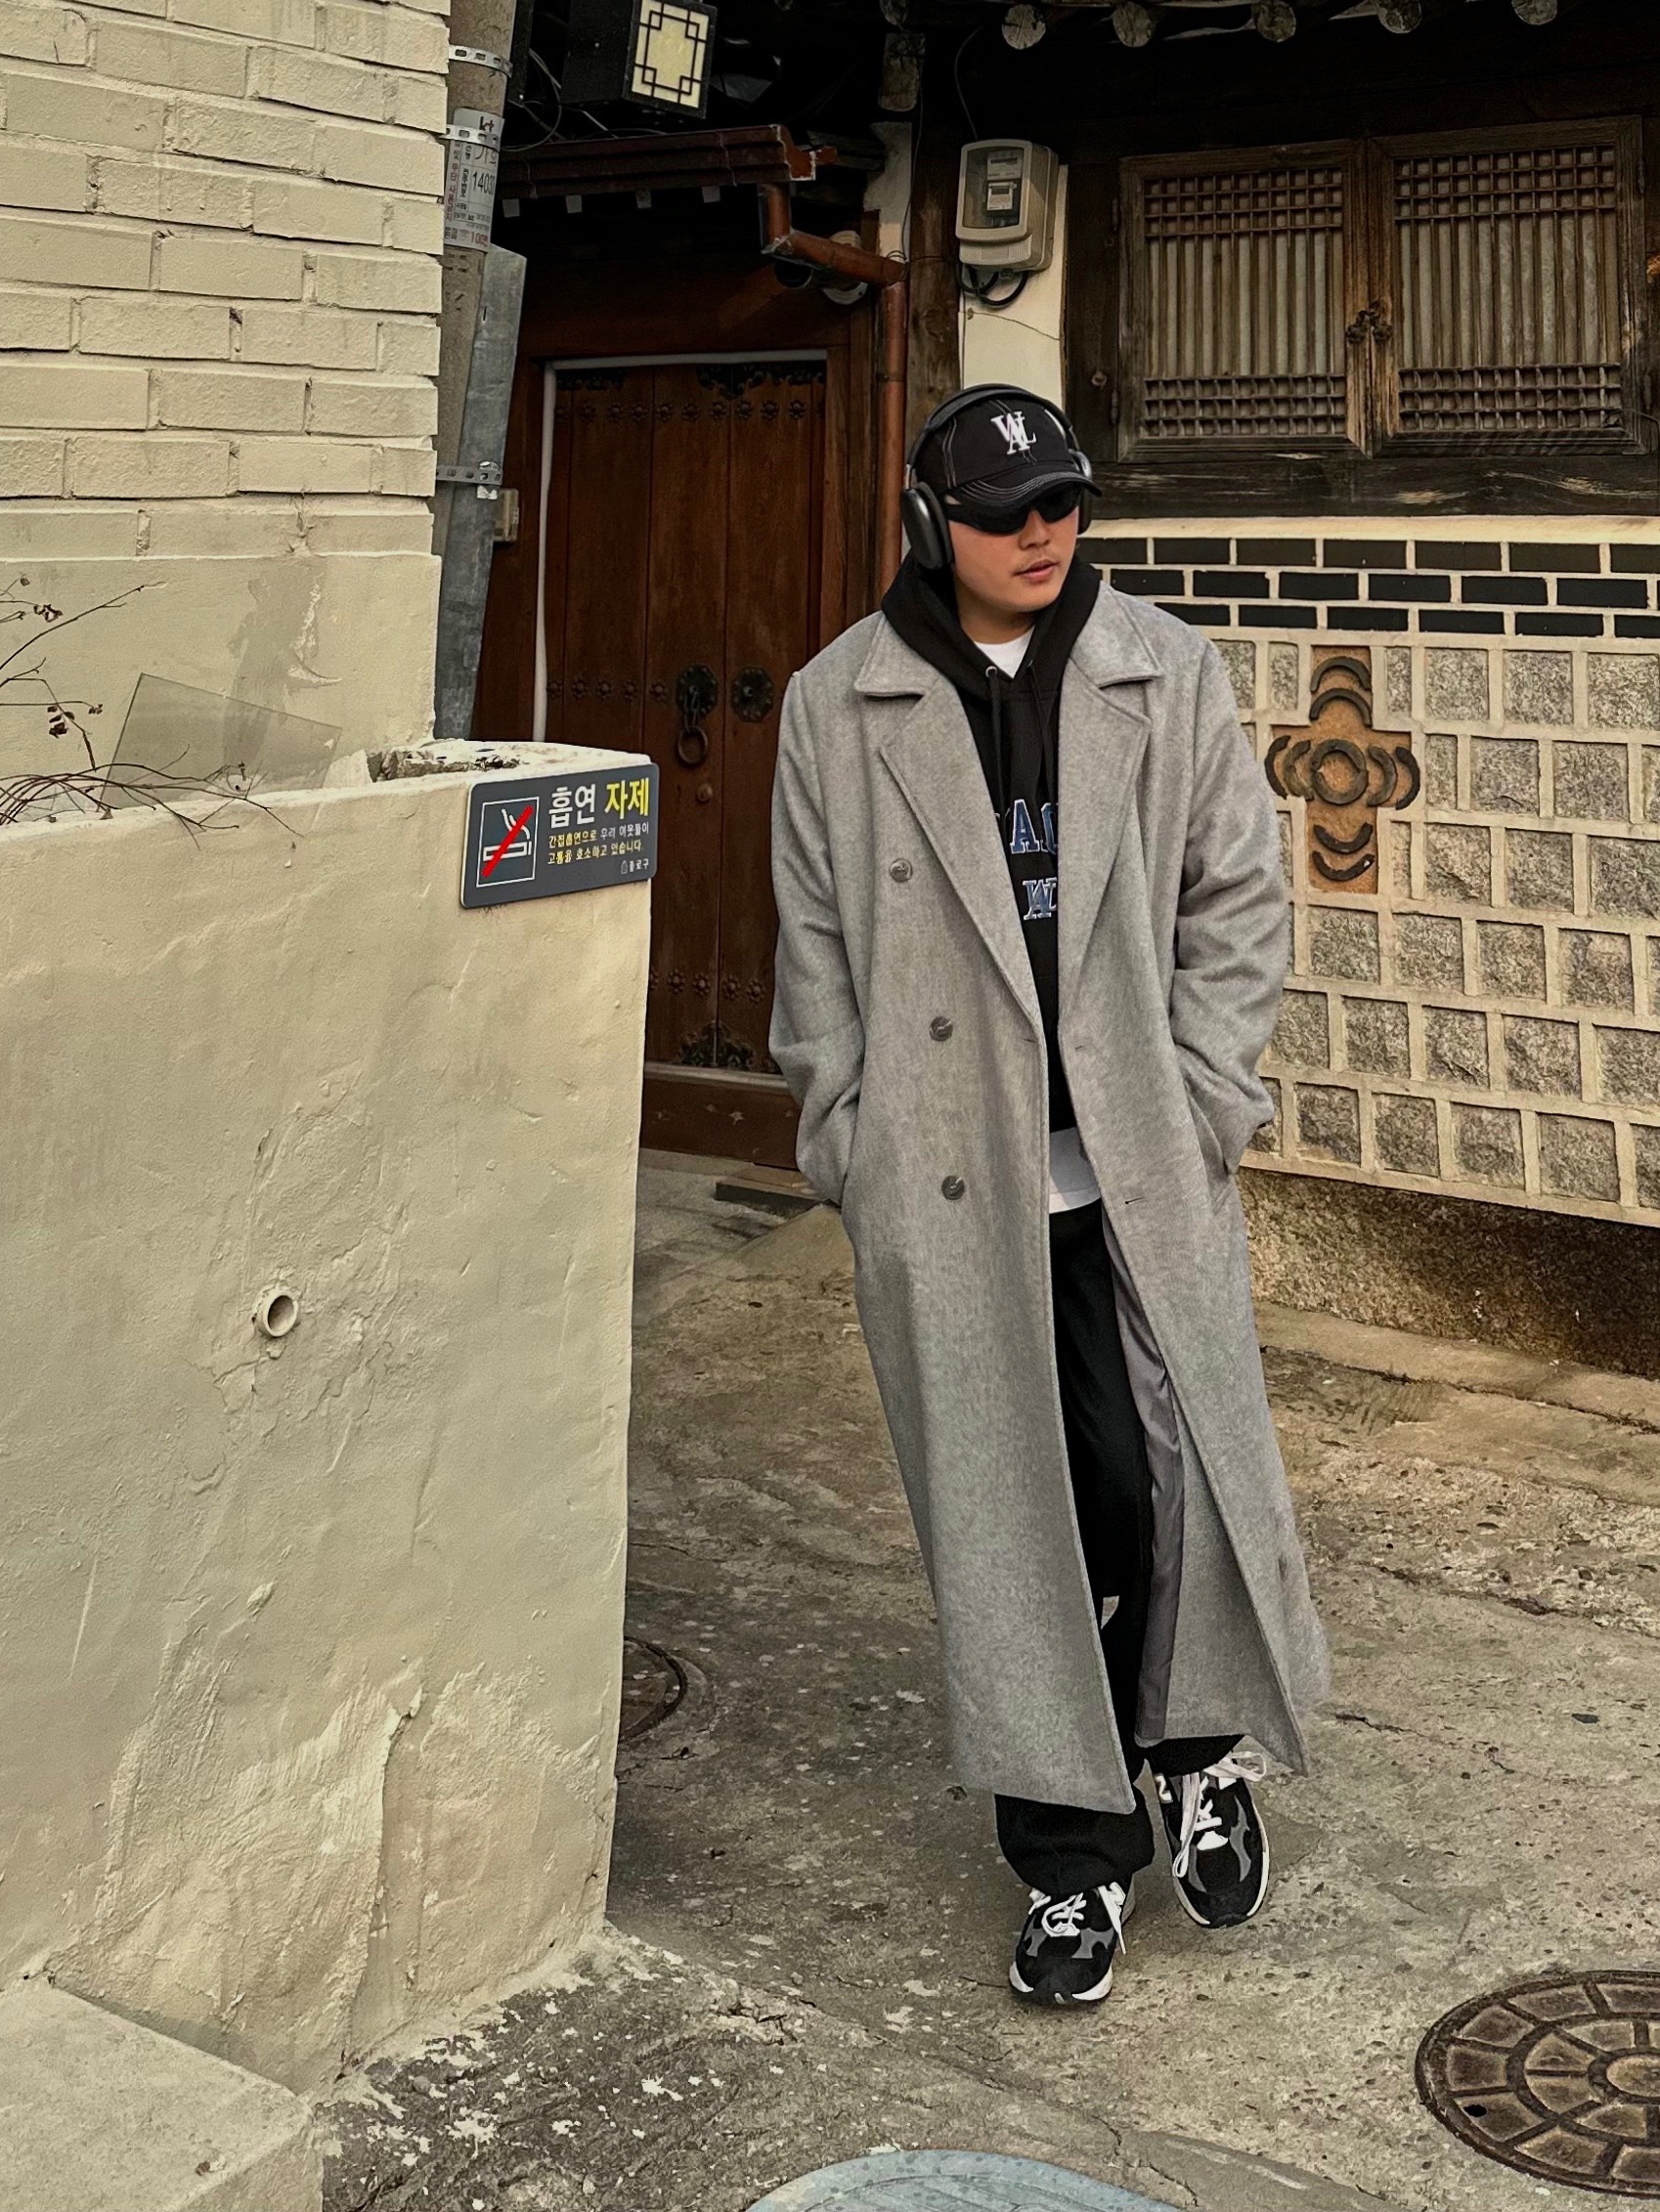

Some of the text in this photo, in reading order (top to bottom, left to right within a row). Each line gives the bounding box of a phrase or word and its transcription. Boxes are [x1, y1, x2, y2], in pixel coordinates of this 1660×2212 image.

[548, 777, 649, 829] 흡연 자제
[547, 829, 597, 848] 간접흡연으로
[600, 826, 616, 841] 우리
[546, 849, 572, 865] 고통을
[575, 844, 607, 861] 호소하고
